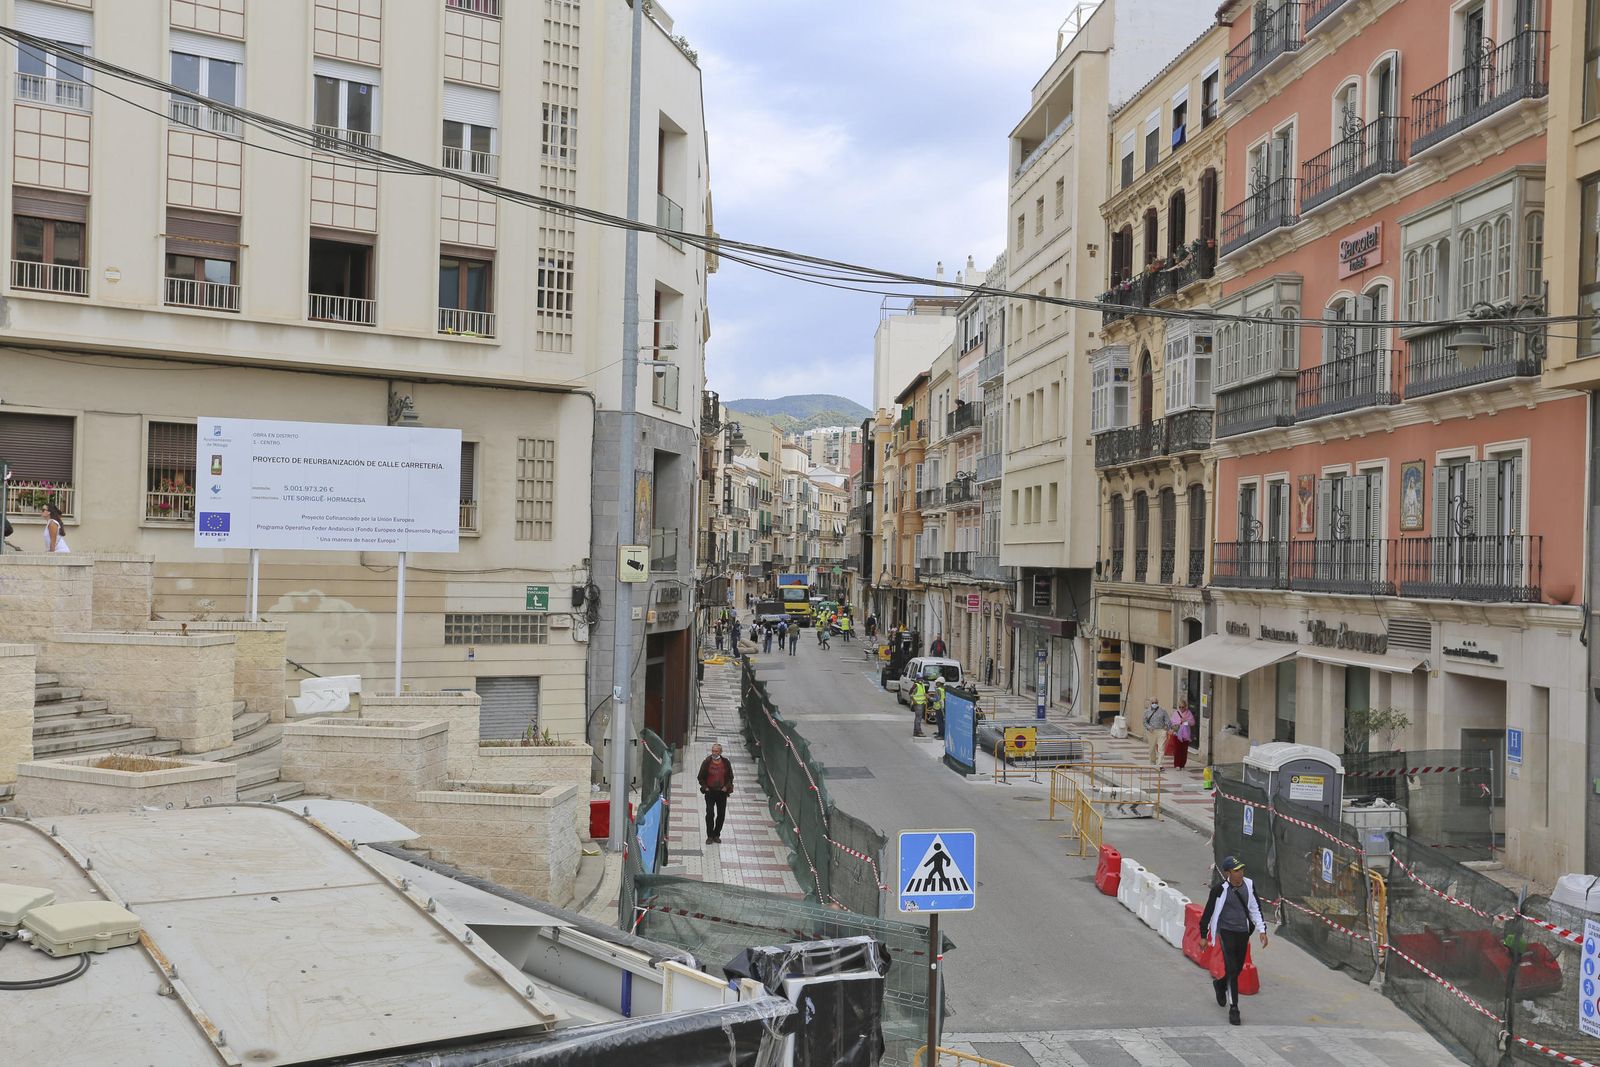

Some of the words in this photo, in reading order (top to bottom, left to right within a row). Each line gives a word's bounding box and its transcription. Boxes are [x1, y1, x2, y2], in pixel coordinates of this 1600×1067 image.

[1341, 226, 1378, 260] Sercotel
[252, 456, 290, 464] PROYECTO
[303, 457, 365, 467] REURBANIZACIÓN
[377, 460, 400, 468] CALLE
[1511, 731, 1518, 748] H
